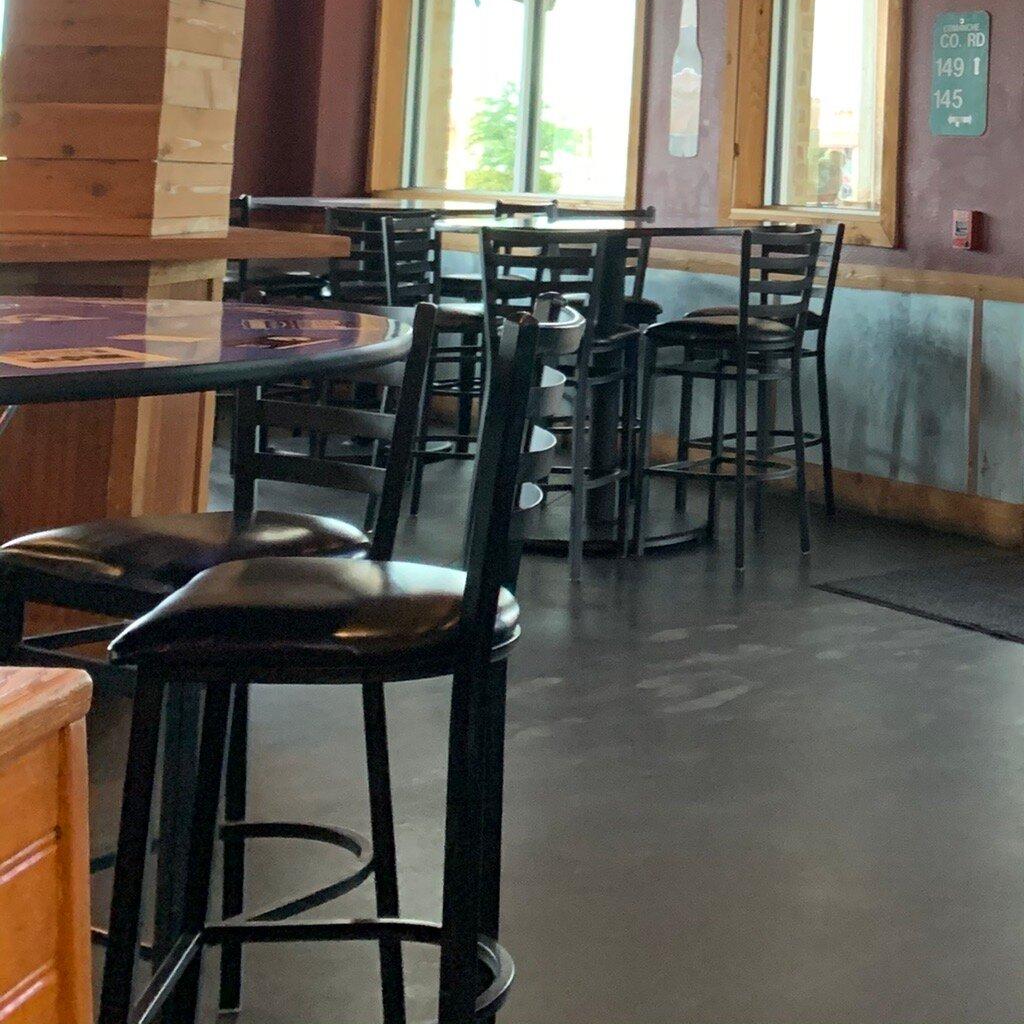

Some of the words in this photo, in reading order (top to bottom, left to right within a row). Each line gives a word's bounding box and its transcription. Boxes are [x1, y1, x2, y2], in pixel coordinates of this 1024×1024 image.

[940, 33, 962, 49] CO.
[967, 32, 986, 48] RD
[935, 57, 965, 78] 149
[933, 88, 963, 109] 145
